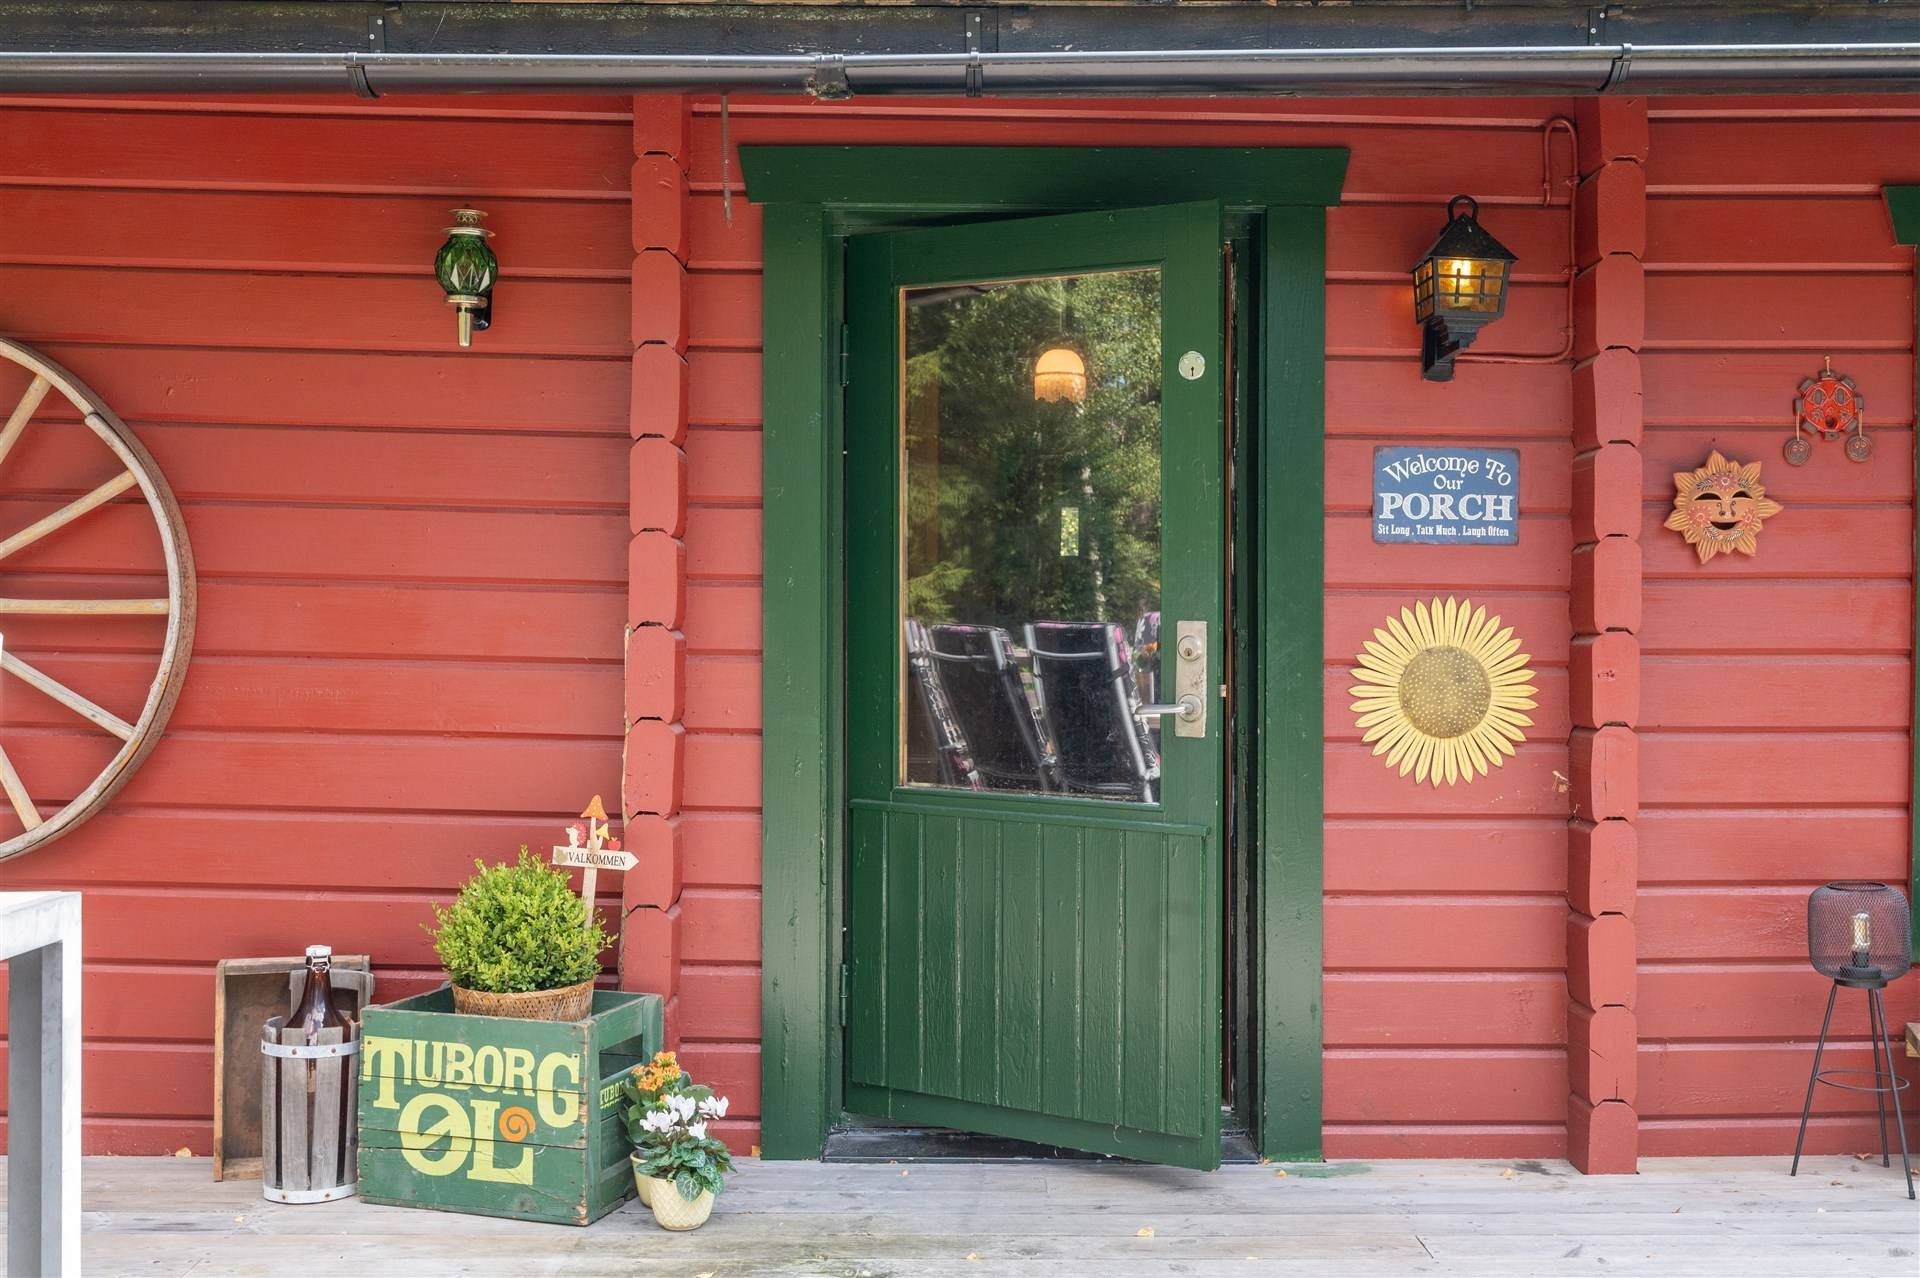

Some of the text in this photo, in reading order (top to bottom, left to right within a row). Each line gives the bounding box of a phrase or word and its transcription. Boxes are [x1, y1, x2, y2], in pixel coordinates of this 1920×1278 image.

[1382, 454, 1512, 487] Welcome To
[1433, 474, 1464, 490] Our
[1378, 492, 1513, 521] PORCH
[1377, 523, 1389, 535] Sit
[1391, 524, 1410, 537] Long
[1435, 524, 1456, 536] Much
[1462, 525, 1486, 538] Laugh
[1487, 525, 1509, 537] Often
[568, 851, 626, 867] VALKOMMEN
[363, 1035, 580, 1129] TUBORG
[397, 1092, 534, 1186] ØL
